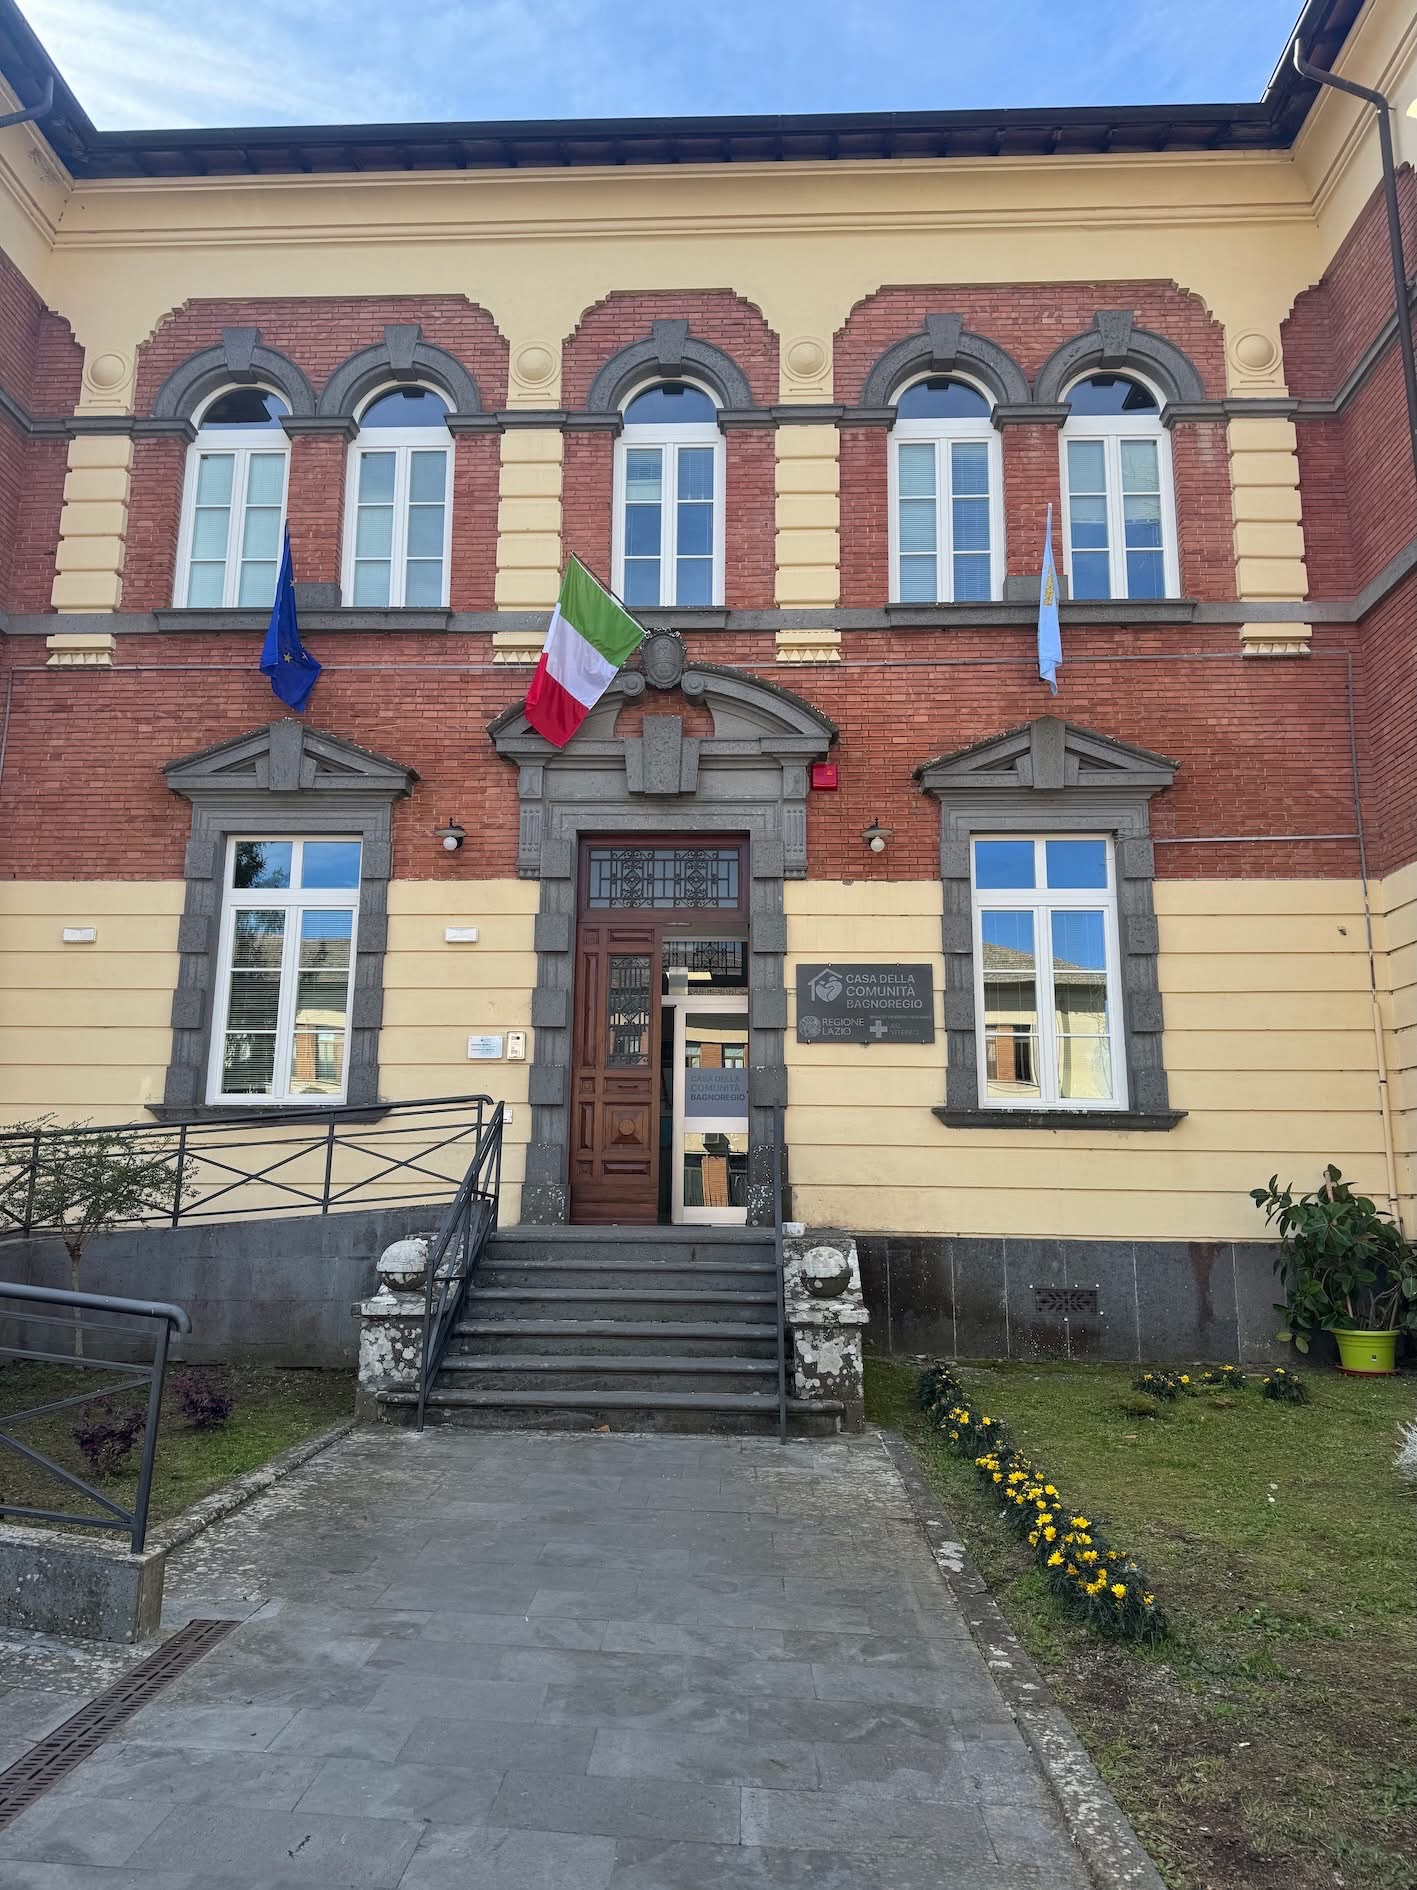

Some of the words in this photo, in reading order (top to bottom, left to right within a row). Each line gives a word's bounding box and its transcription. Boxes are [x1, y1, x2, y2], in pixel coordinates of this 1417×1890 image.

[845, 974, 876, 984] CASA
[879, 974, 915, 984] DELLA
[845, 983, 916, 997] COMUNITÀ
[846, 999, 923, 1009] BAGNOREGIO
[822, 1018, 865, 1027] REGIONE
[822, 1027, 852, 1036] LAZIO
[690, 1083, 741, 1092] COMUNITÀ
[690, 1093, 746, 1101] BAGNOREGIO
